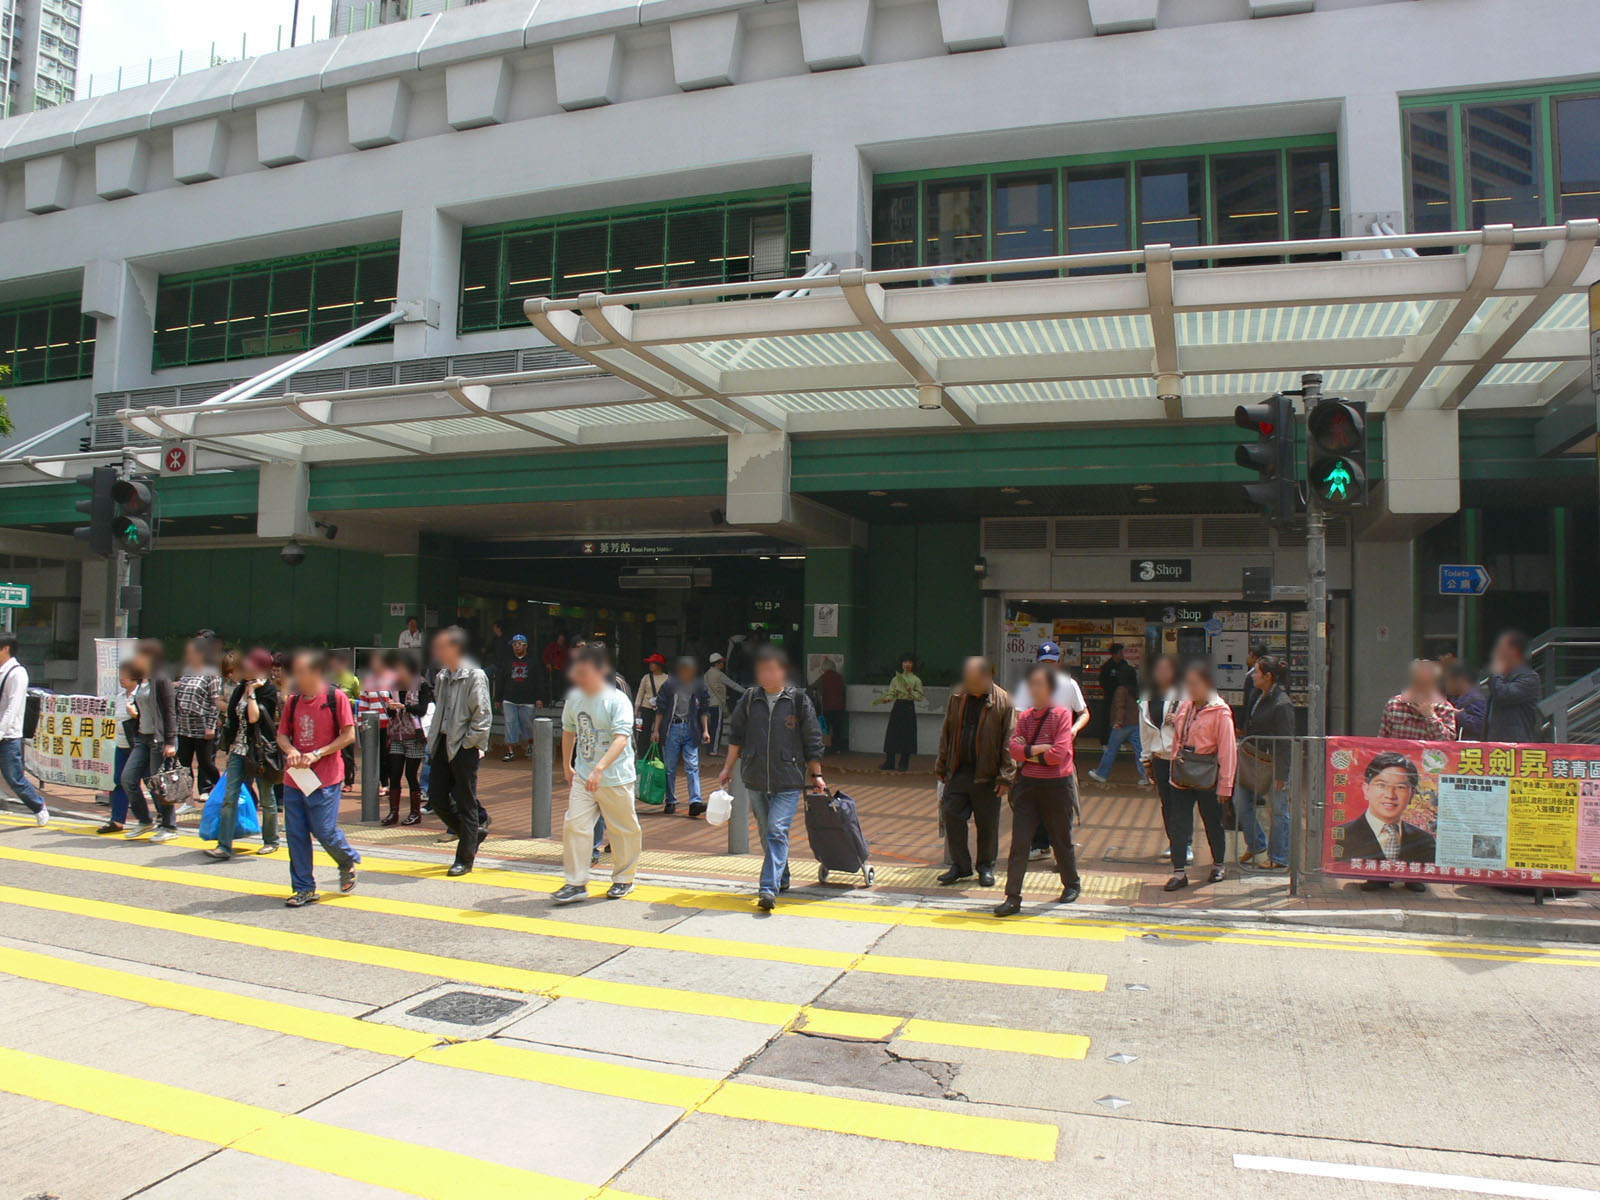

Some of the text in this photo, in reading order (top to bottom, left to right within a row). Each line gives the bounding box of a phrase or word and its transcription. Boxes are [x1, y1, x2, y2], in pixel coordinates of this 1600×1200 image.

[600, 542, 631, 554] 葵芳站
[1139, 561, 1182, 581] 3 Shop
[1444, 569, 1470, 577] Toilets
[1447, 579, 1472, 589] 公廁
[1177, 608, 1201, 622] Shop
[39, 714, 116, 739] 宿舍用地
[1458, 748, 1549, 778] 吳劍昇
